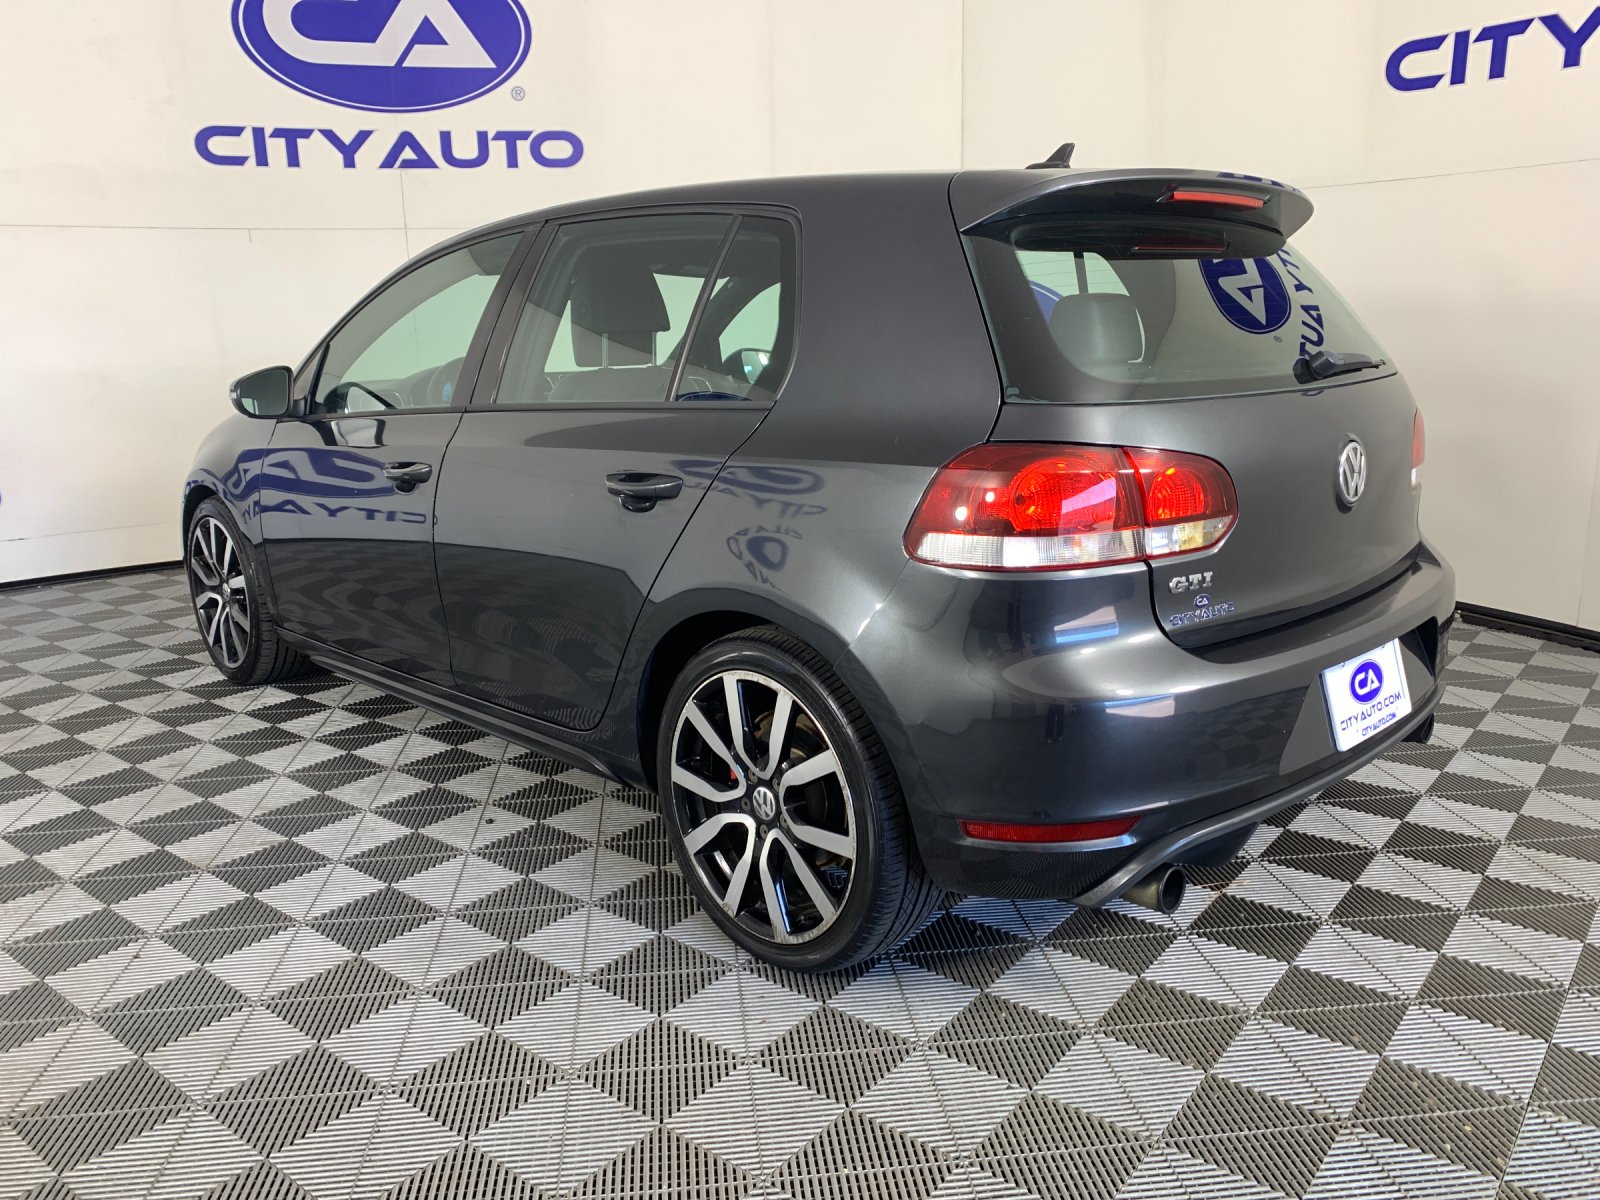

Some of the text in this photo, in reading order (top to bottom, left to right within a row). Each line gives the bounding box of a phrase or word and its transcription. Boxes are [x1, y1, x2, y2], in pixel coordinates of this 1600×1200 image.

[1385, 6, 1600, 92] CITY
[1168, 571, 1213, 594] GTI
[1354, 668, 1381, 696] CA
